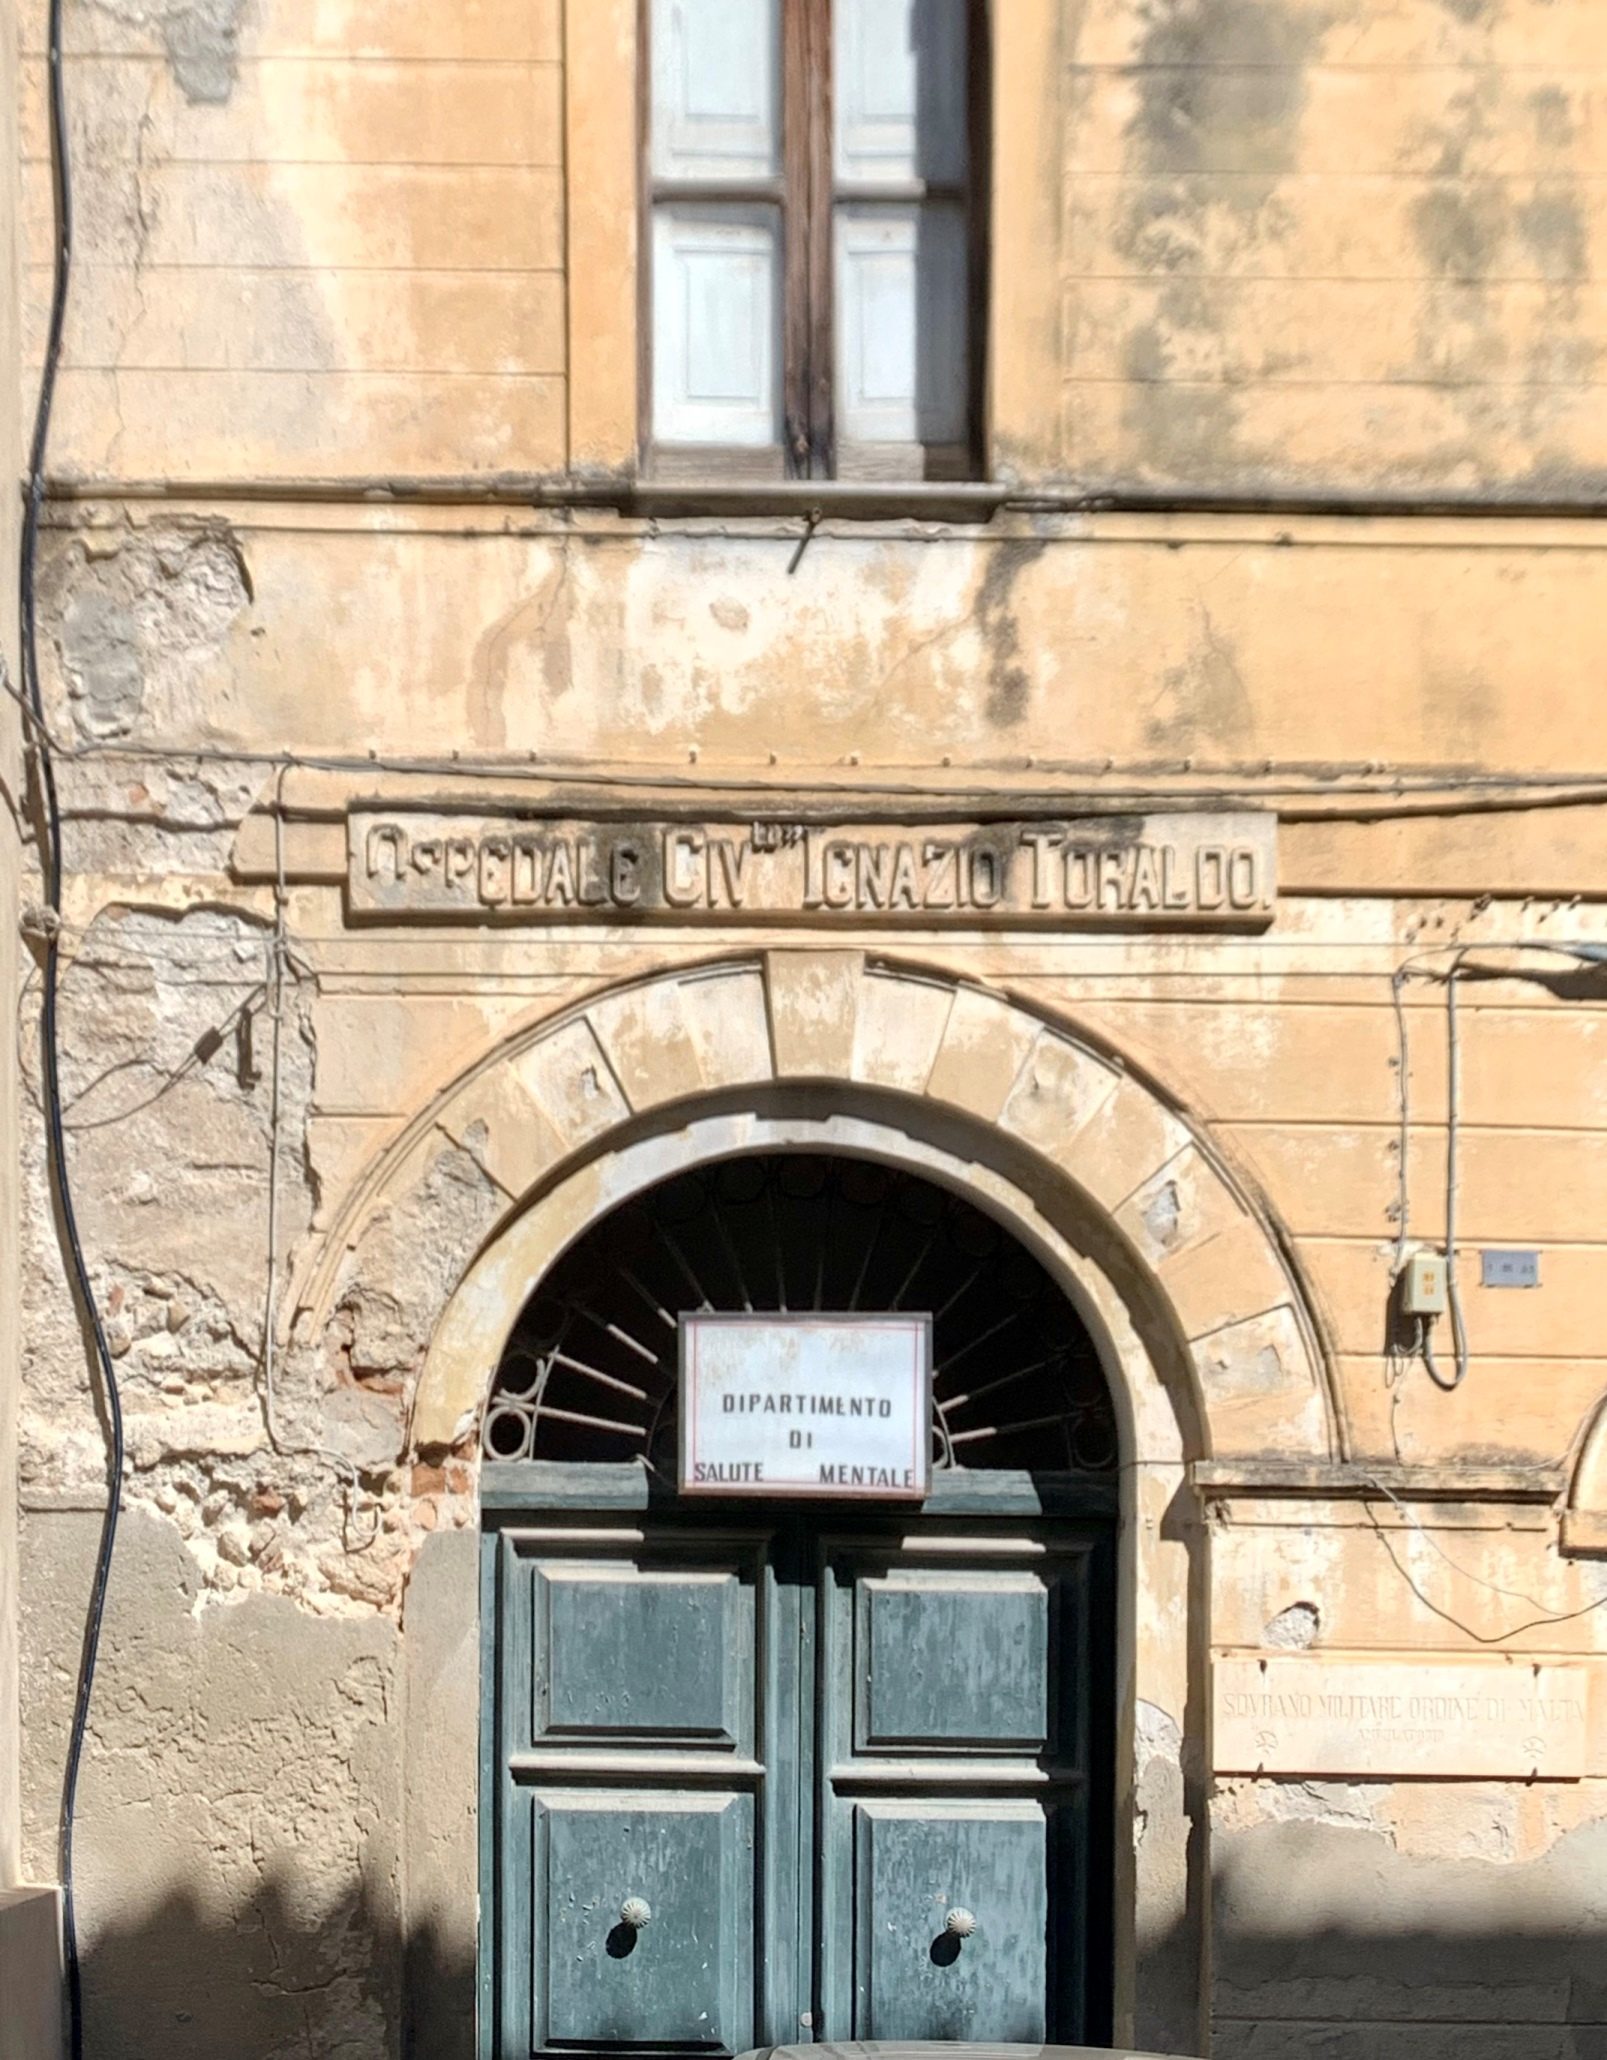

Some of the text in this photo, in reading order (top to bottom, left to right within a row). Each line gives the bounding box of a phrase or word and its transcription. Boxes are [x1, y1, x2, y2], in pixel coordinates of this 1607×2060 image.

[802, 829, 1003, 909] IGNAZIO
[722, 1392, 893, 1419] DIPARTIMENTO
[788, 1429, 812, 1449] DI
[695, 1462, 914, 1488] SALUTE MENTALE
[1222, 1693, 1312, 1718] SOVRANO
[1317, 1694, 1402, 1719] MILITARE
[1408, 1696, 1479, 1720] ORDINE
[1485, 1697, 1505, 1722] DI
